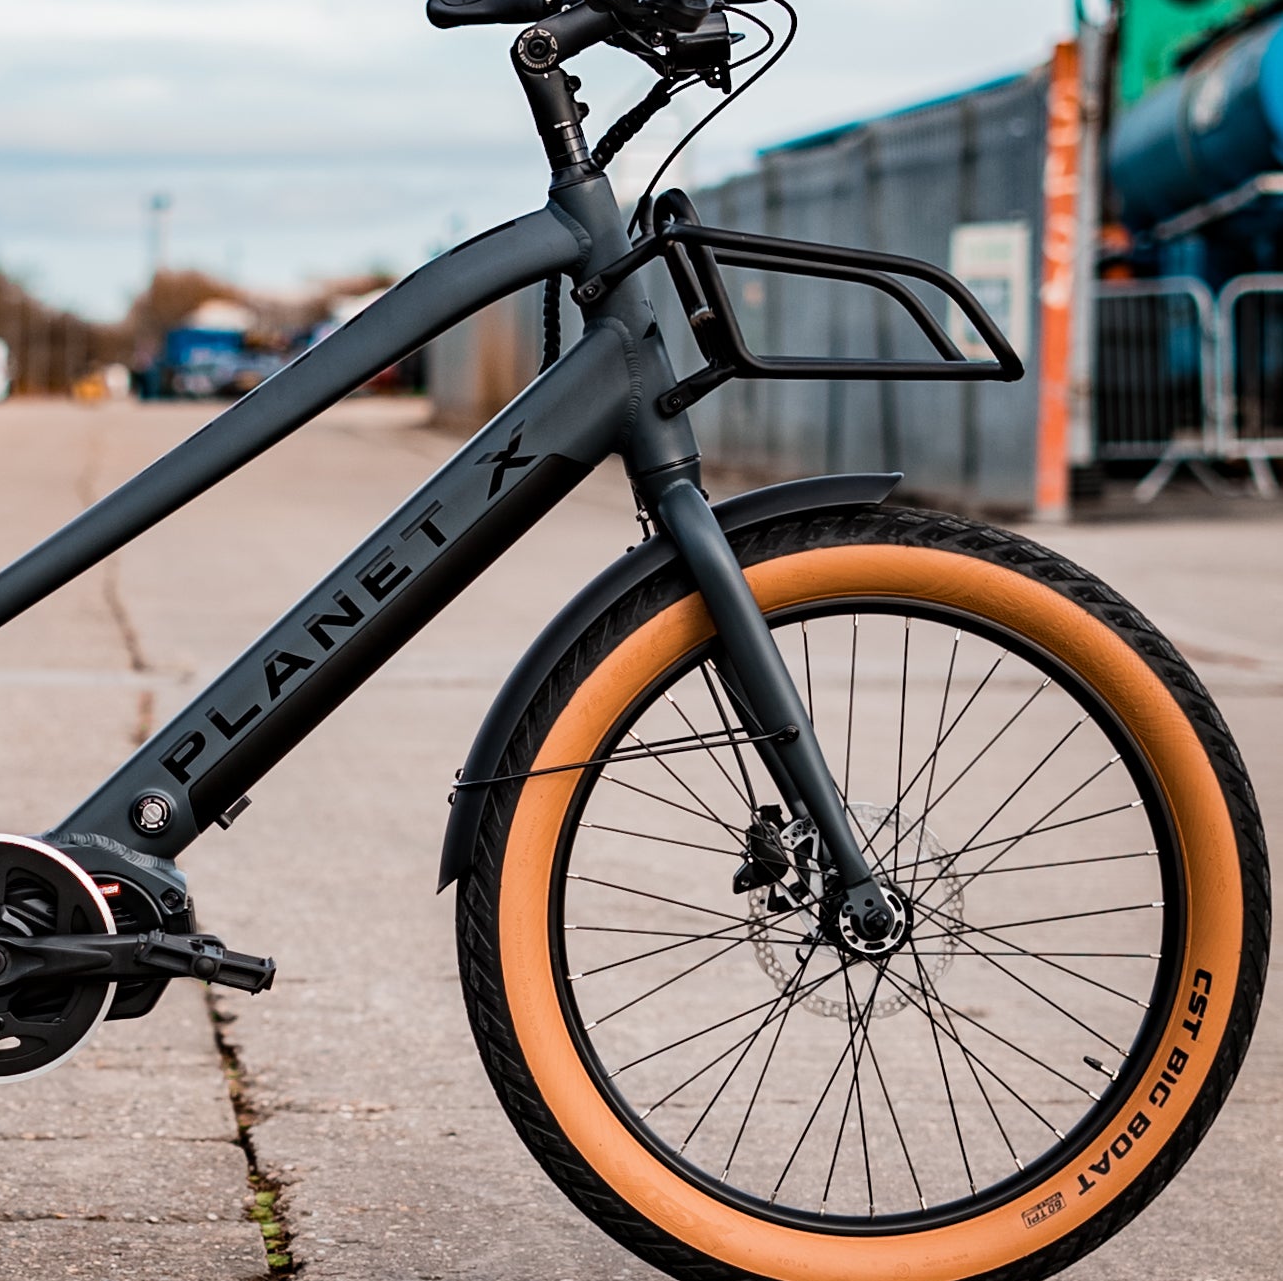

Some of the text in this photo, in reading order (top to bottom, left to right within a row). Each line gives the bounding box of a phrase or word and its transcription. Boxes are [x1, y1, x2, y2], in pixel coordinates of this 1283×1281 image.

[157, 419, 538, 785] PLANET X
[1076, 968, 1213, 1196] CST BIG BOAT
[1026, 1209, 1047, 1226] TPI
[1047, 1199, 1063, 1214] 60
